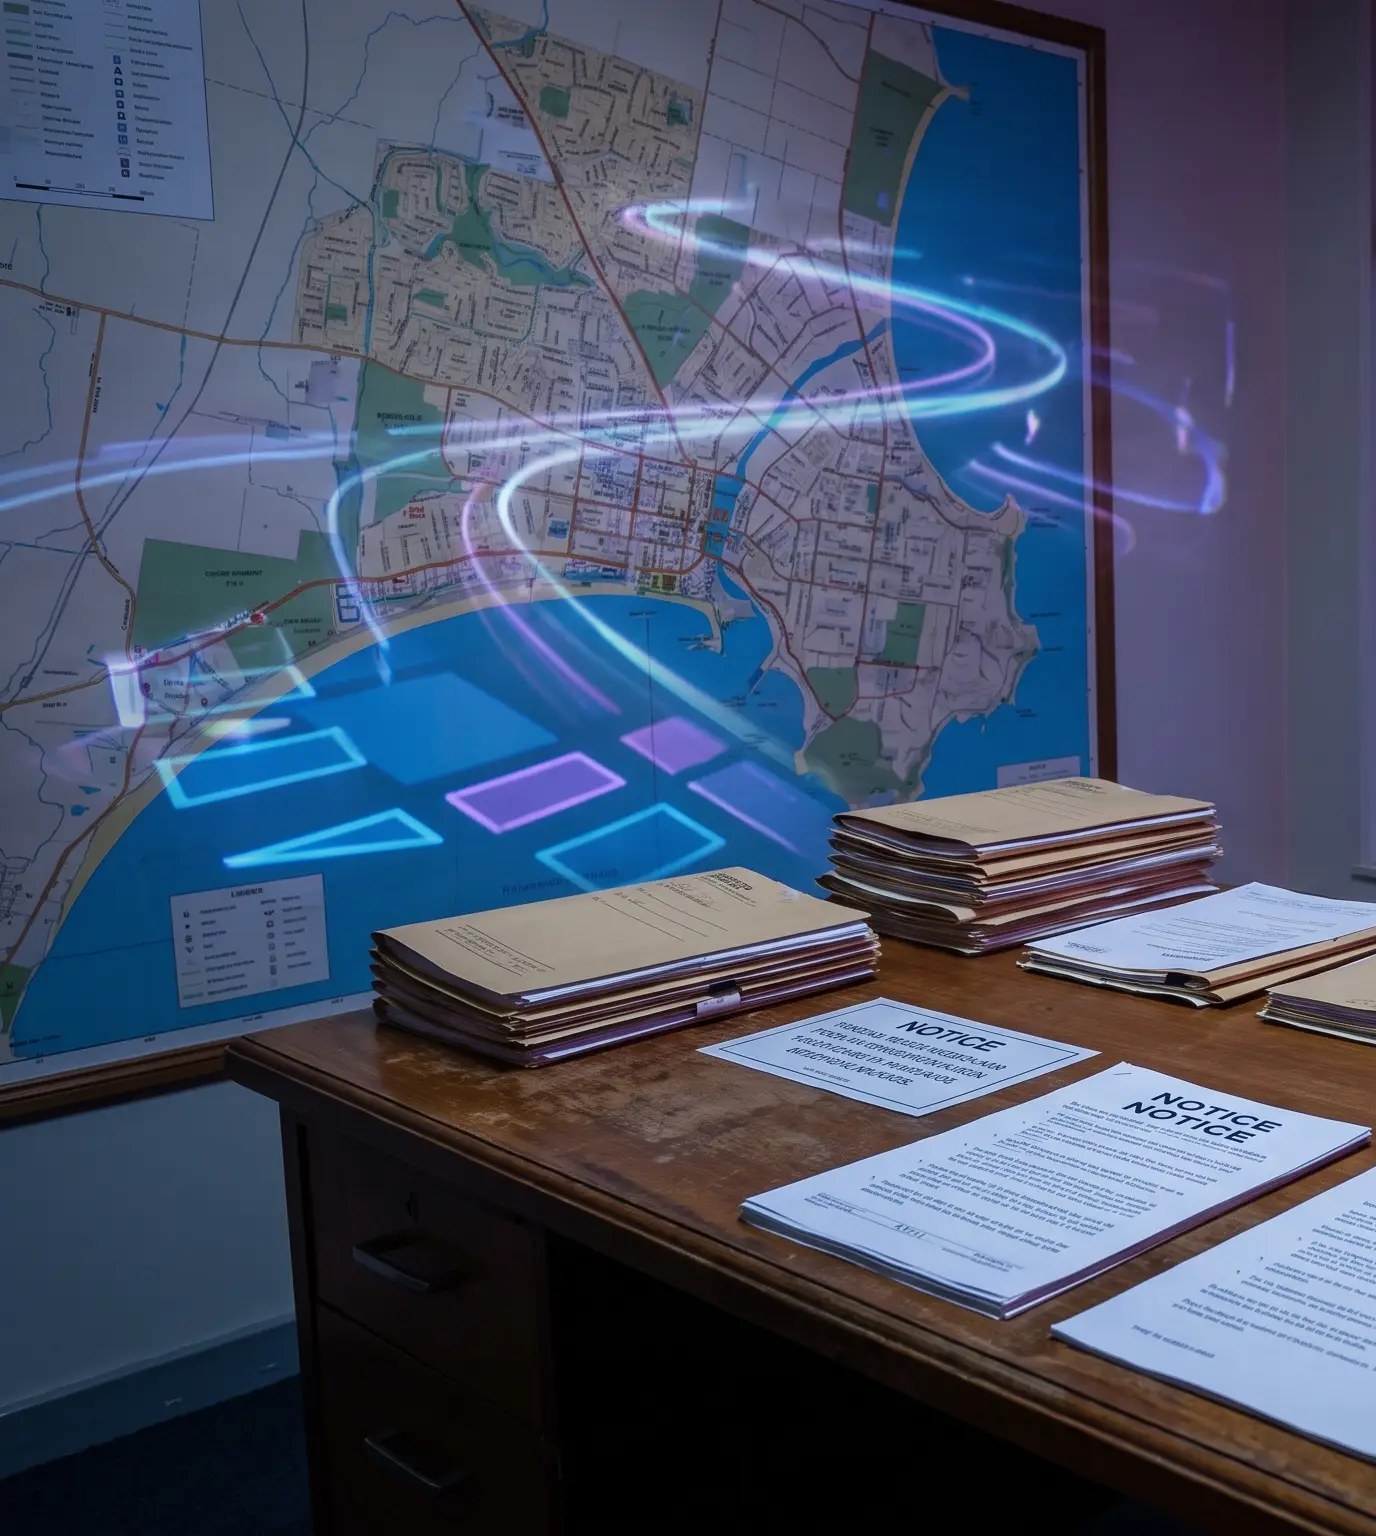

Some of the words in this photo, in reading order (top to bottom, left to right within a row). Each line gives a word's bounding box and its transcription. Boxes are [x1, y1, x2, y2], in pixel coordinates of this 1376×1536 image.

[897, 1020, 1008, 1053] NOTICE
[1121, 1101, 1257, 1144] NOTICE
[1150, 1092, 1283, 1134] NOTICE
